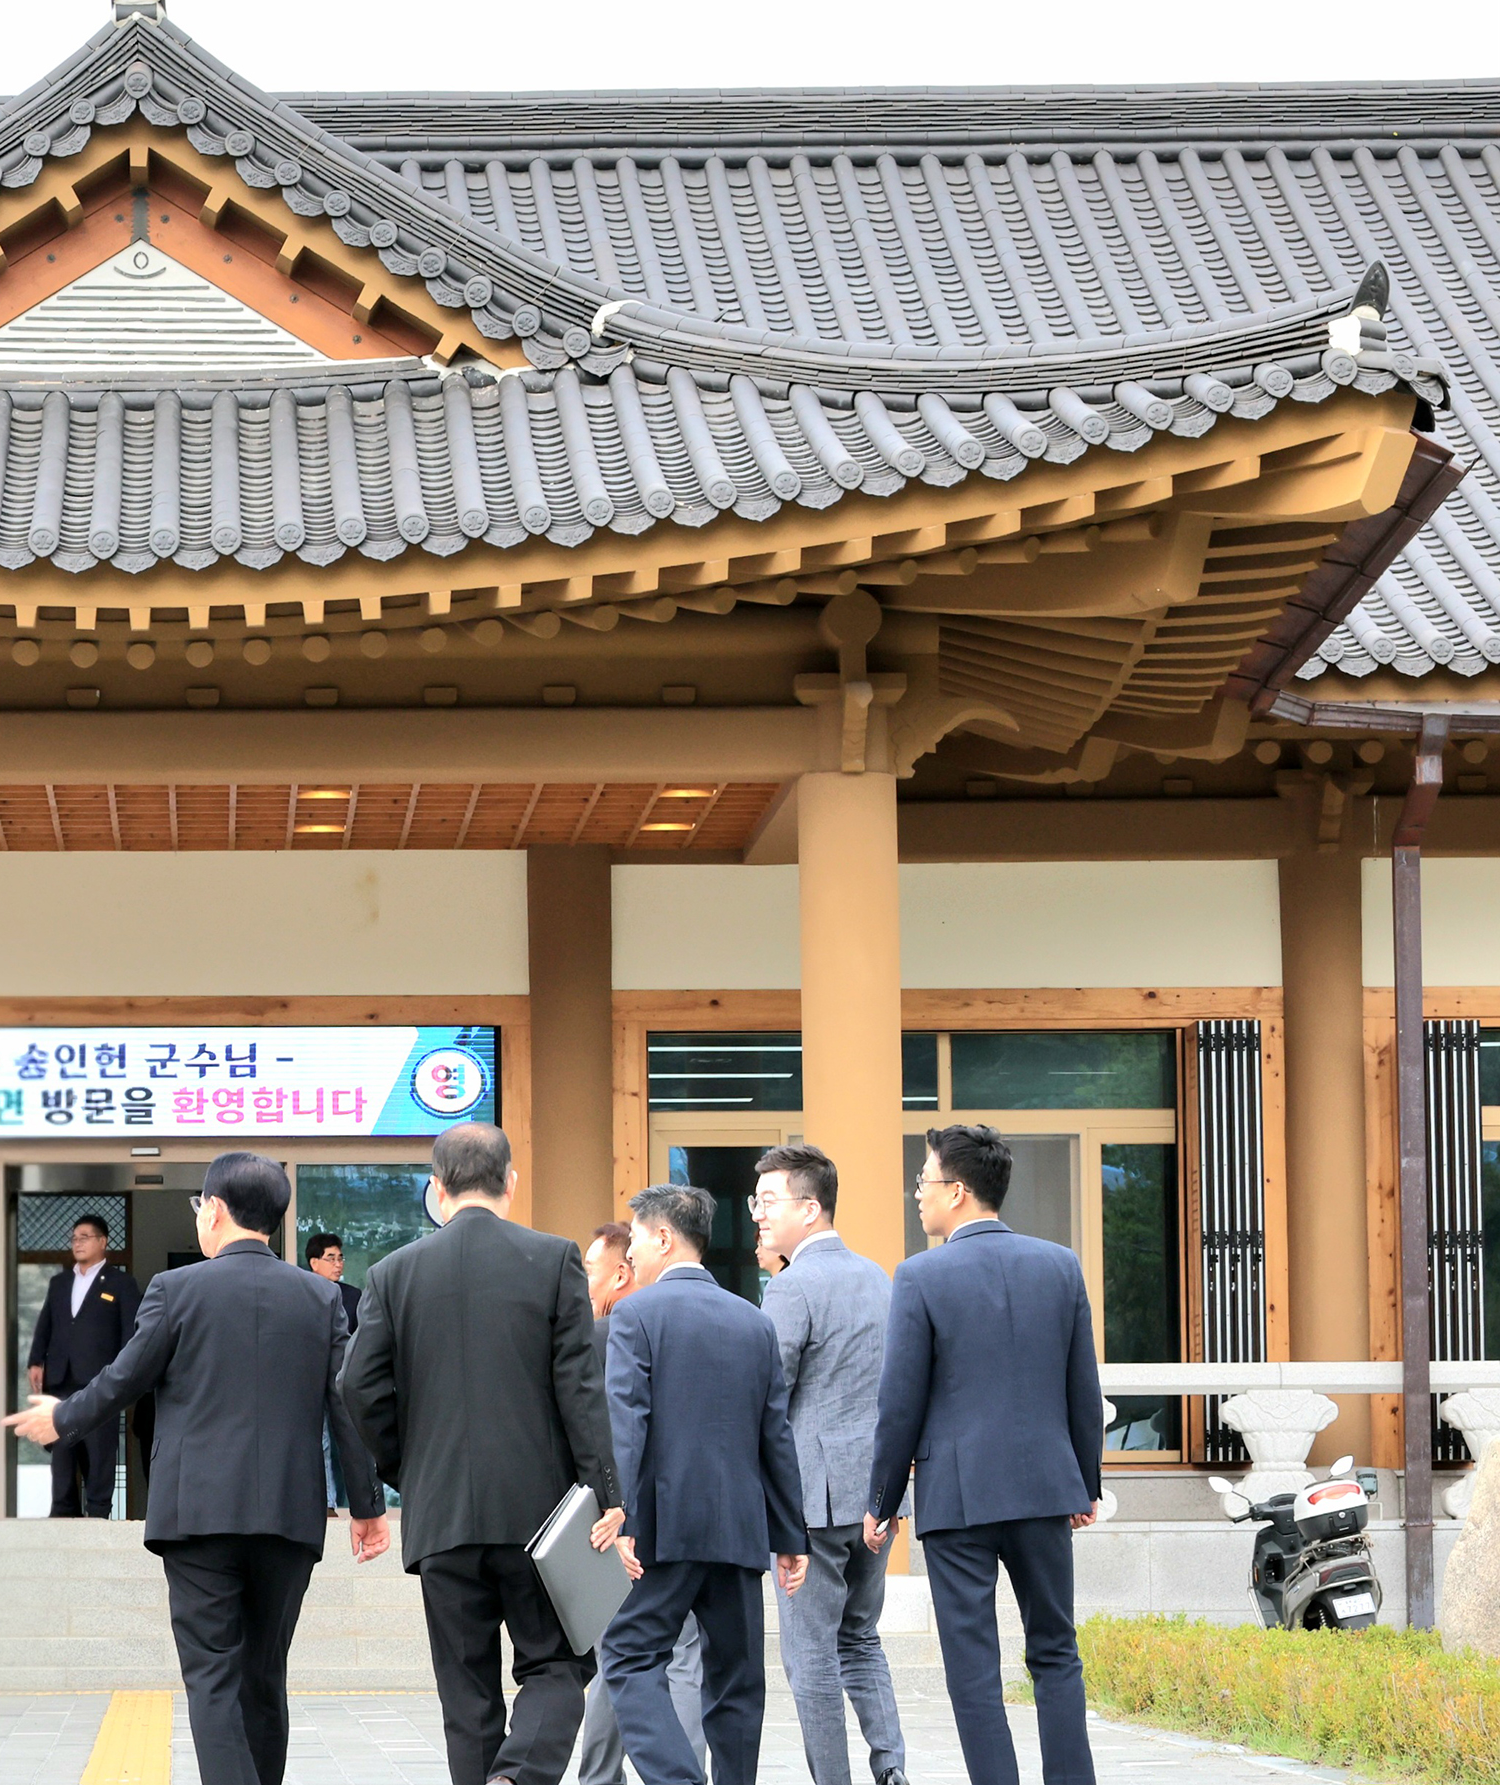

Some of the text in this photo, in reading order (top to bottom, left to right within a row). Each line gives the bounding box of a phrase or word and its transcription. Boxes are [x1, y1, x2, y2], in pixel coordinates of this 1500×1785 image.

[145, 1043, 257, 1079] 군수님
[40, 1086, 156, 1125] 방문을
[172, 1086, 368, 1124] 환영합니다
